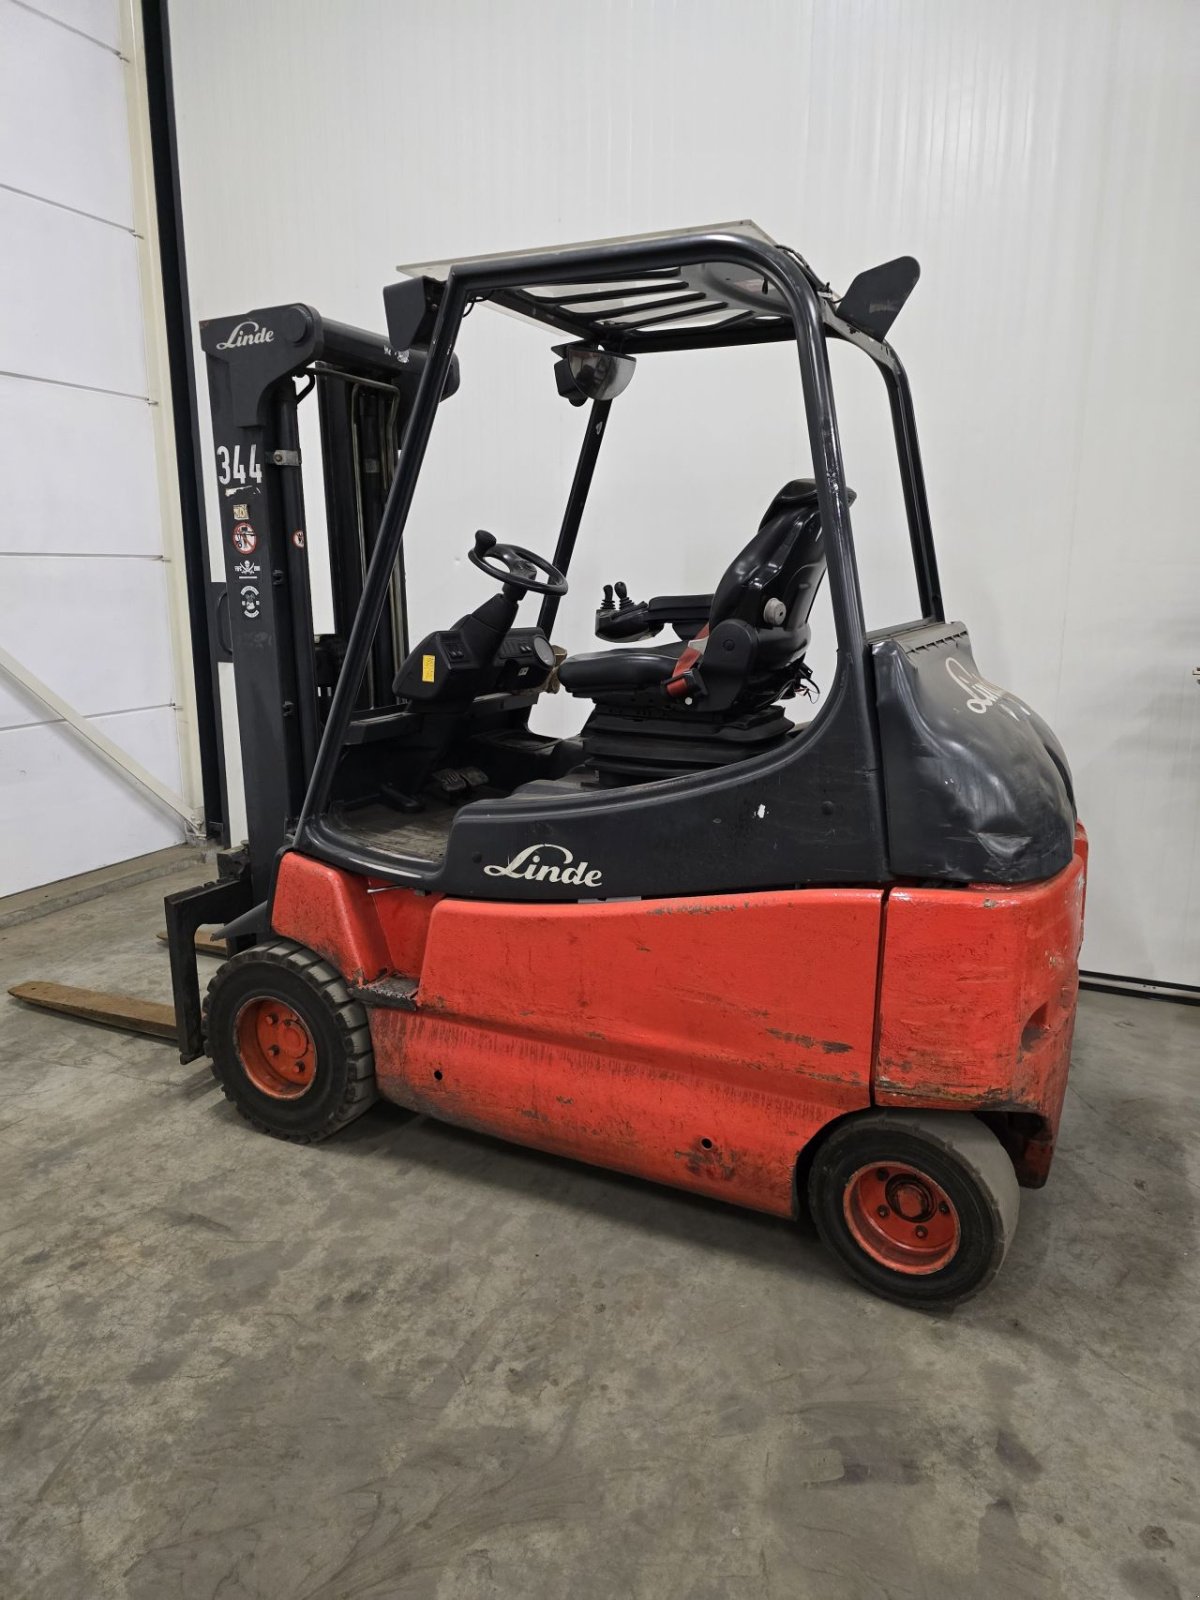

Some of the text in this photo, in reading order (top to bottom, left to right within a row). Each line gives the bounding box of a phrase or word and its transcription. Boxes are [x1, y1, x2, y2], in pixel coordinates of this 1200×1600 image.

[216, 321, 274, 350] Linde
[216, 444, 262, 485] 344
[483, 843, 602, 887] Linde
